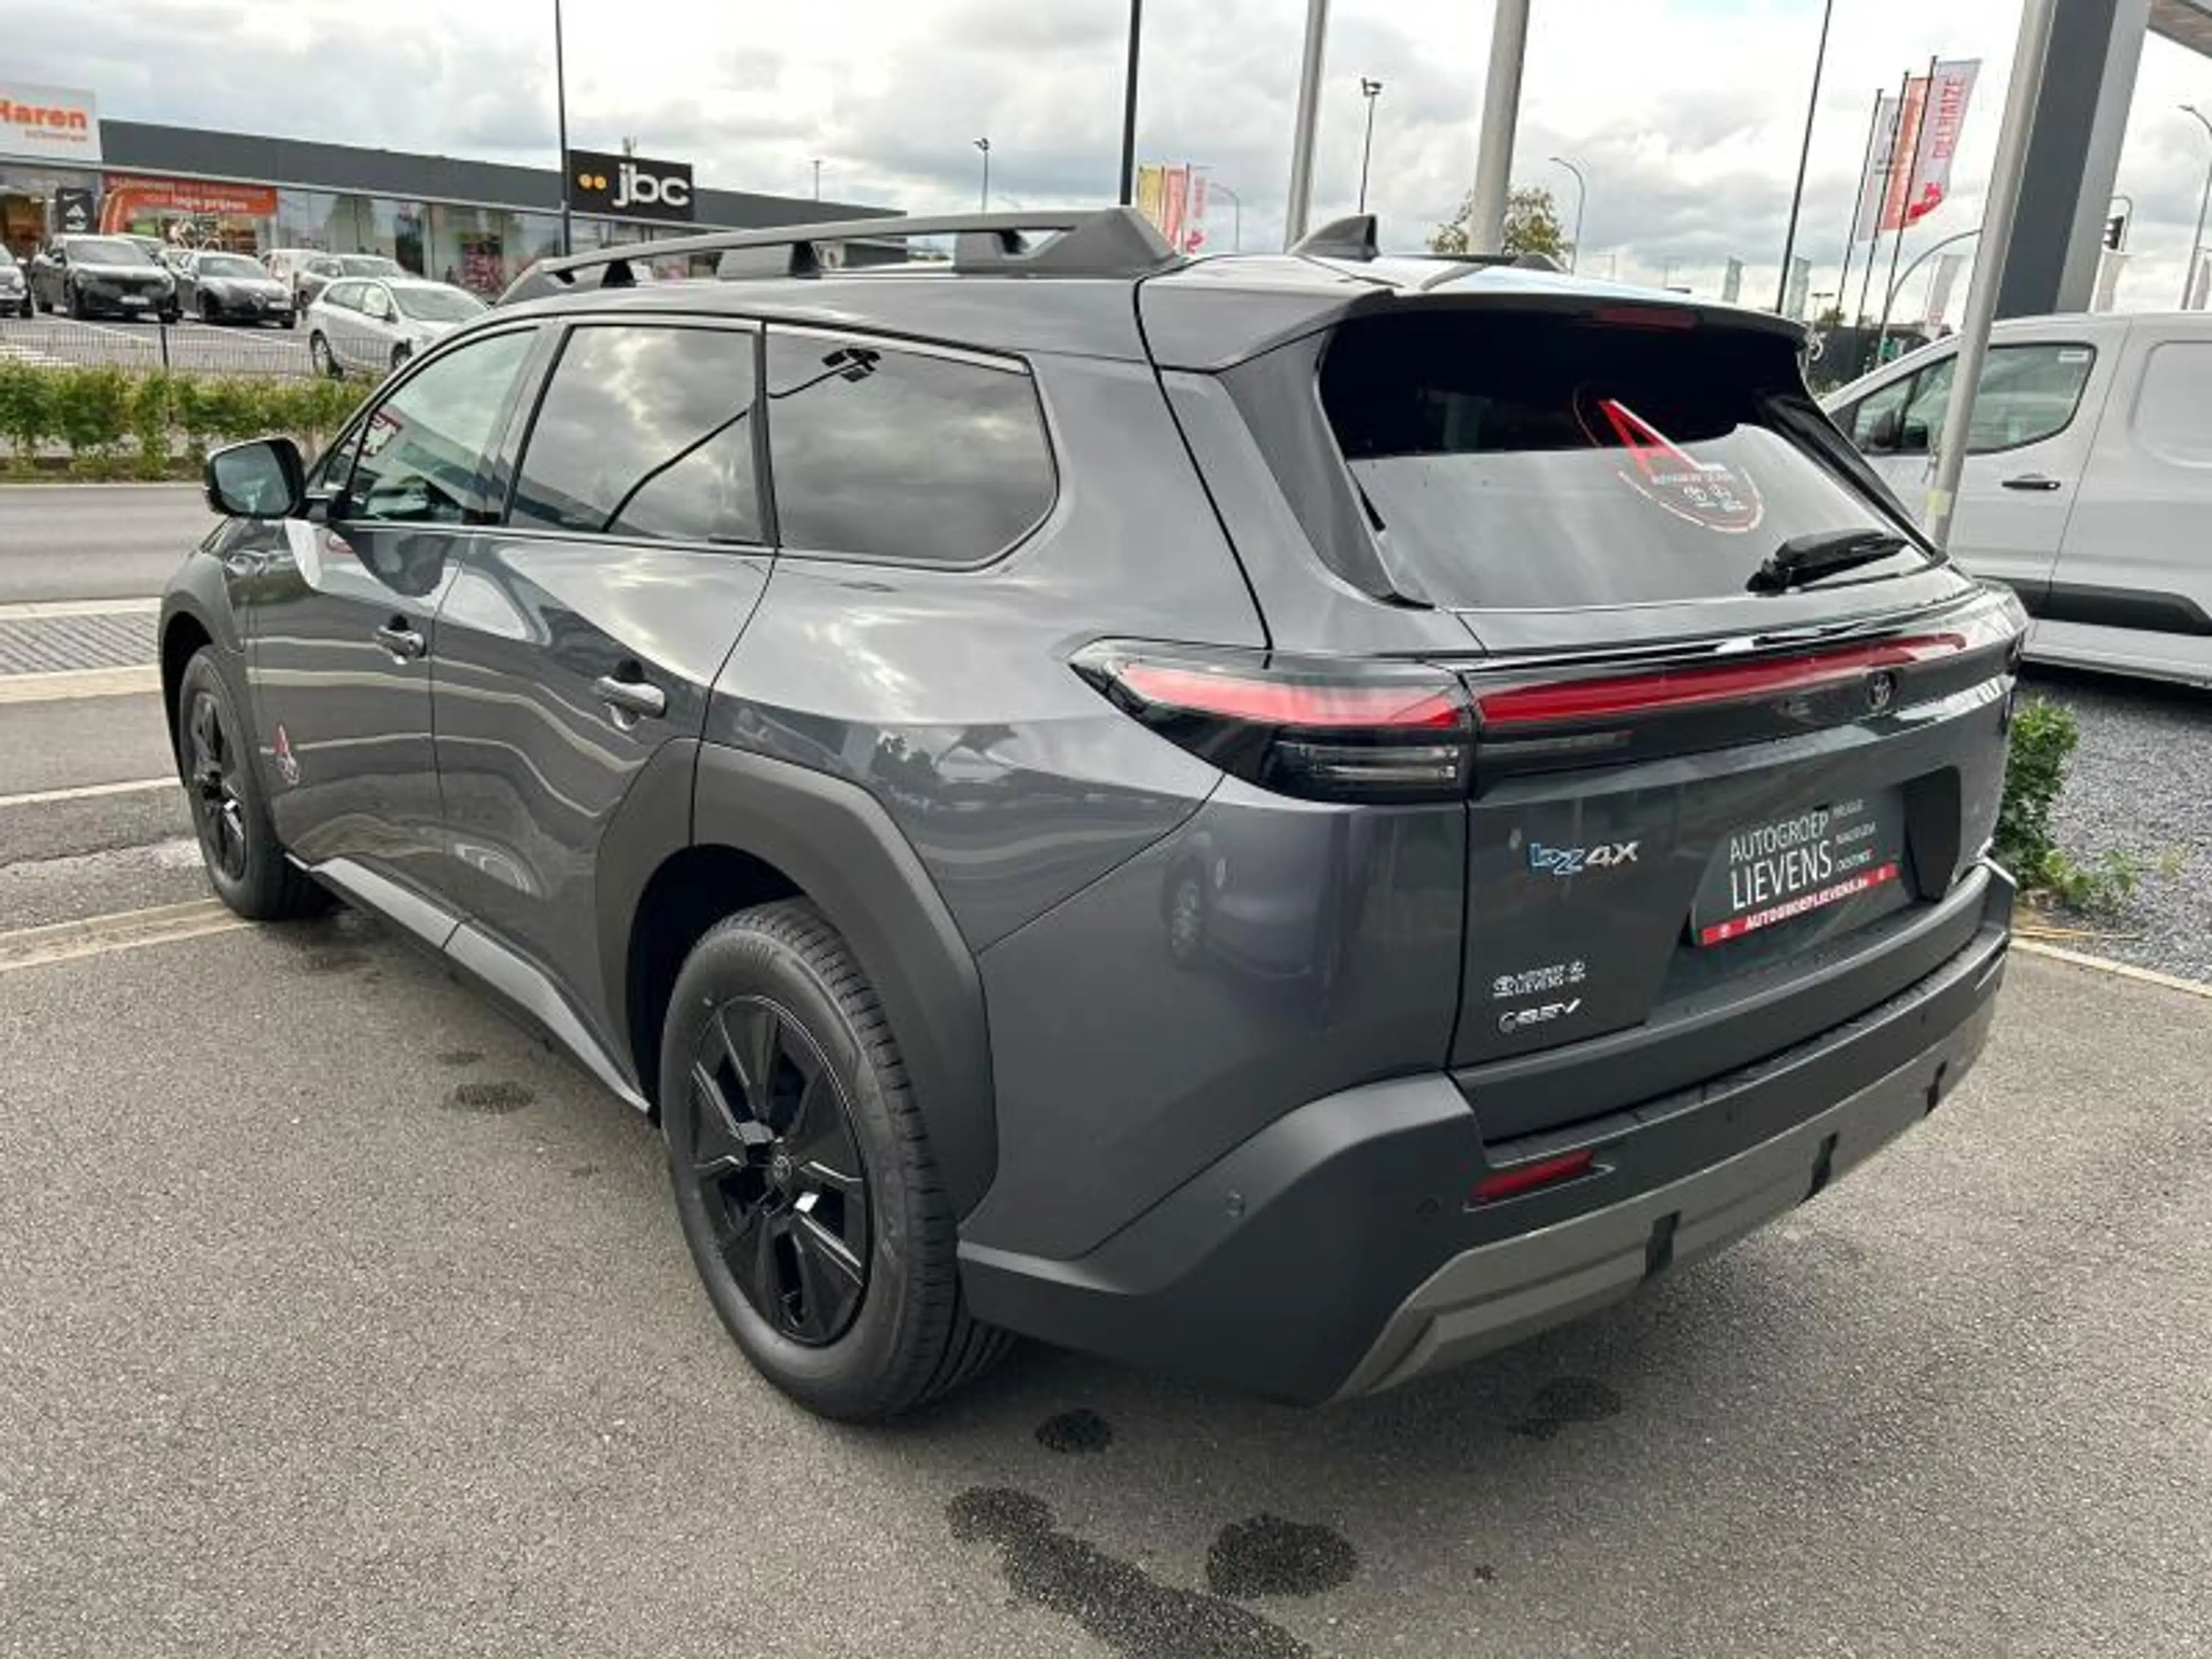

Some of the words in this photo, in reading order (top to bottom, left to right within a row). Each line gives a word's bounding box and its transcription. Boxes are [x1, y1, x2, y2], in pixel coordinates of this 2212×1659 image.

[612, 163, 690, 207] jbc
[1730, 812, 1830, 862] AUTOGROEP
[1730, 840, 1833, 911] LIEVENS
